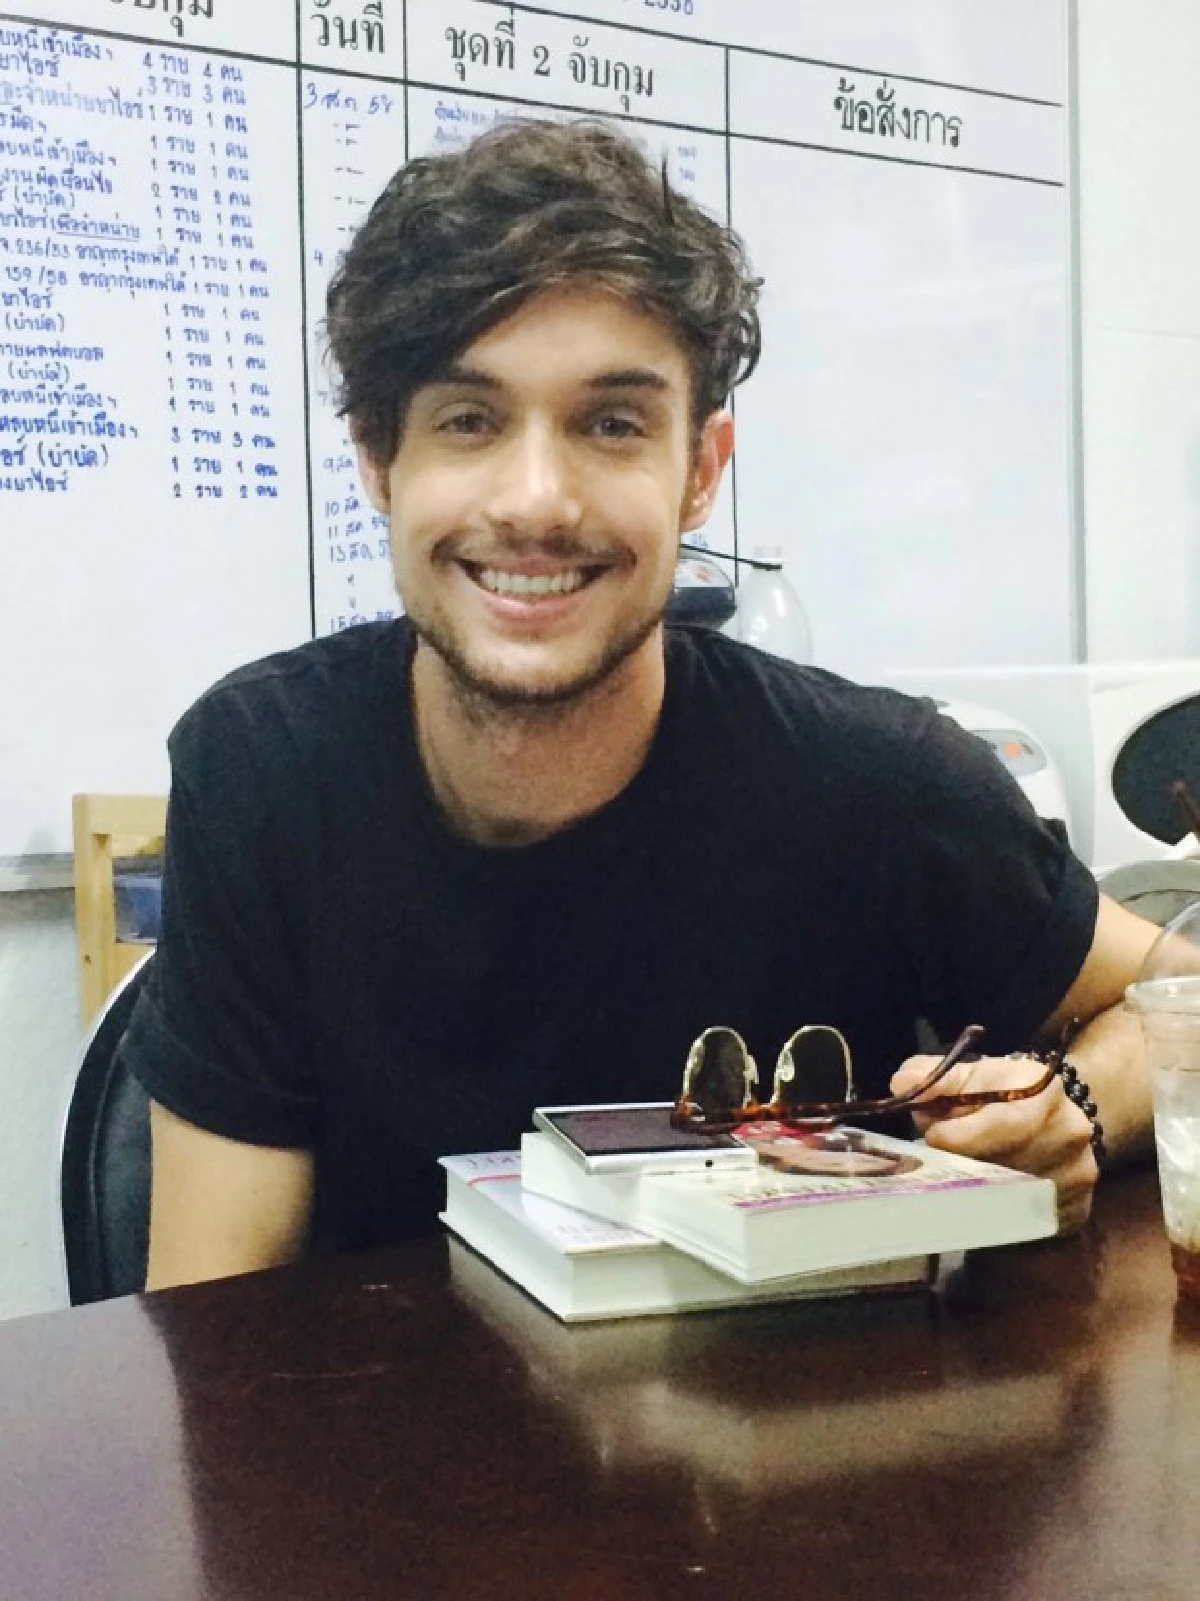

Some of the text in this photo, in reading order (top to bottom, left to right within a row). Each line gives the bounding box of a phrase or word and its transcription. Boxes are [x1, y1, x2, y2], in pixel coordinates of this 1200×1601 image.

[304, 82, 317, 109] 3
[445, 10, 654, 113] ชุดที่ 2 จับกุม
[833, 77, 963, 148] ข้อสั่งการ
